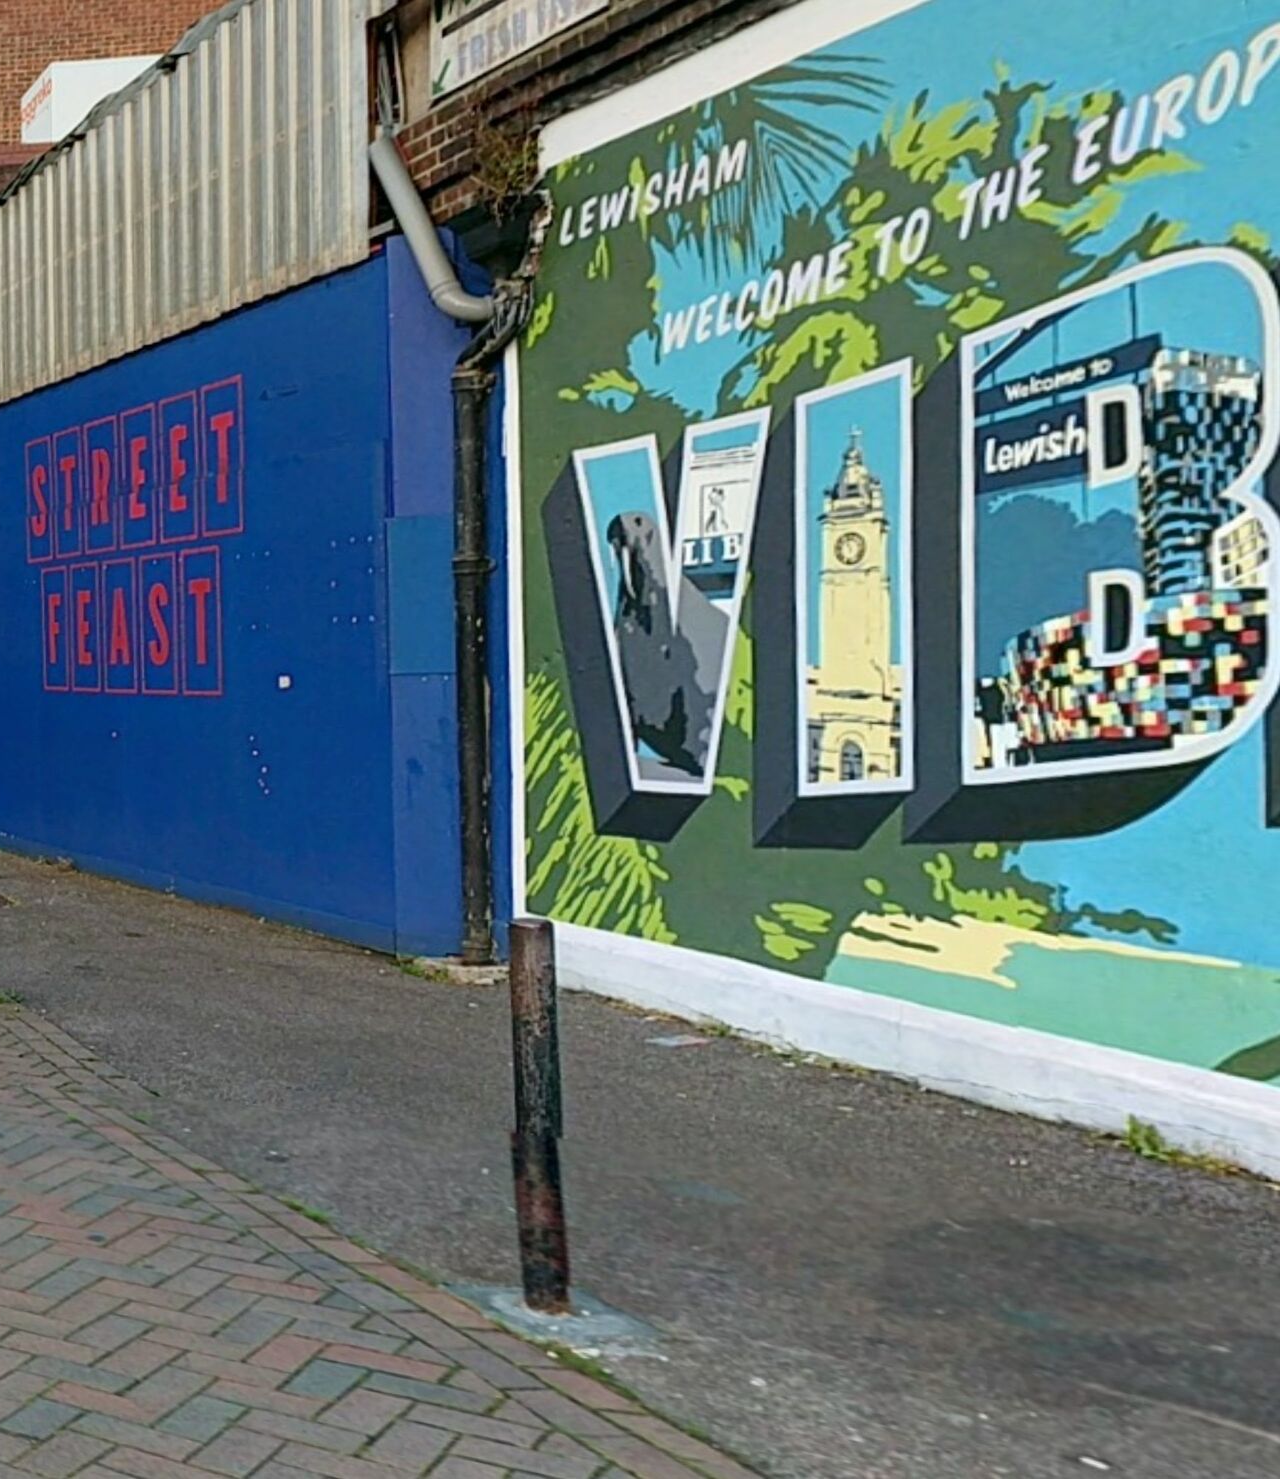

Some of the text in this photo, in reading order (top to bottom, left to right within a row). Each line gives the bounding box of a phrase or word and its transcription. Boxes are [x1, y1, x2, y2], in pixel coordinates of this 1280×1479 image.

[559, 139, 748, 246] LEWISHAM
[663, 241, 853, 354] WELCOME
[875, 207, 931, 278] TO
[959, 144, 1050, 240] THE
[1004, 357, 1114, 402] Welcome to
[31, 411, 235, 537] STREET
[48, 578, 213, 667] FEAST
